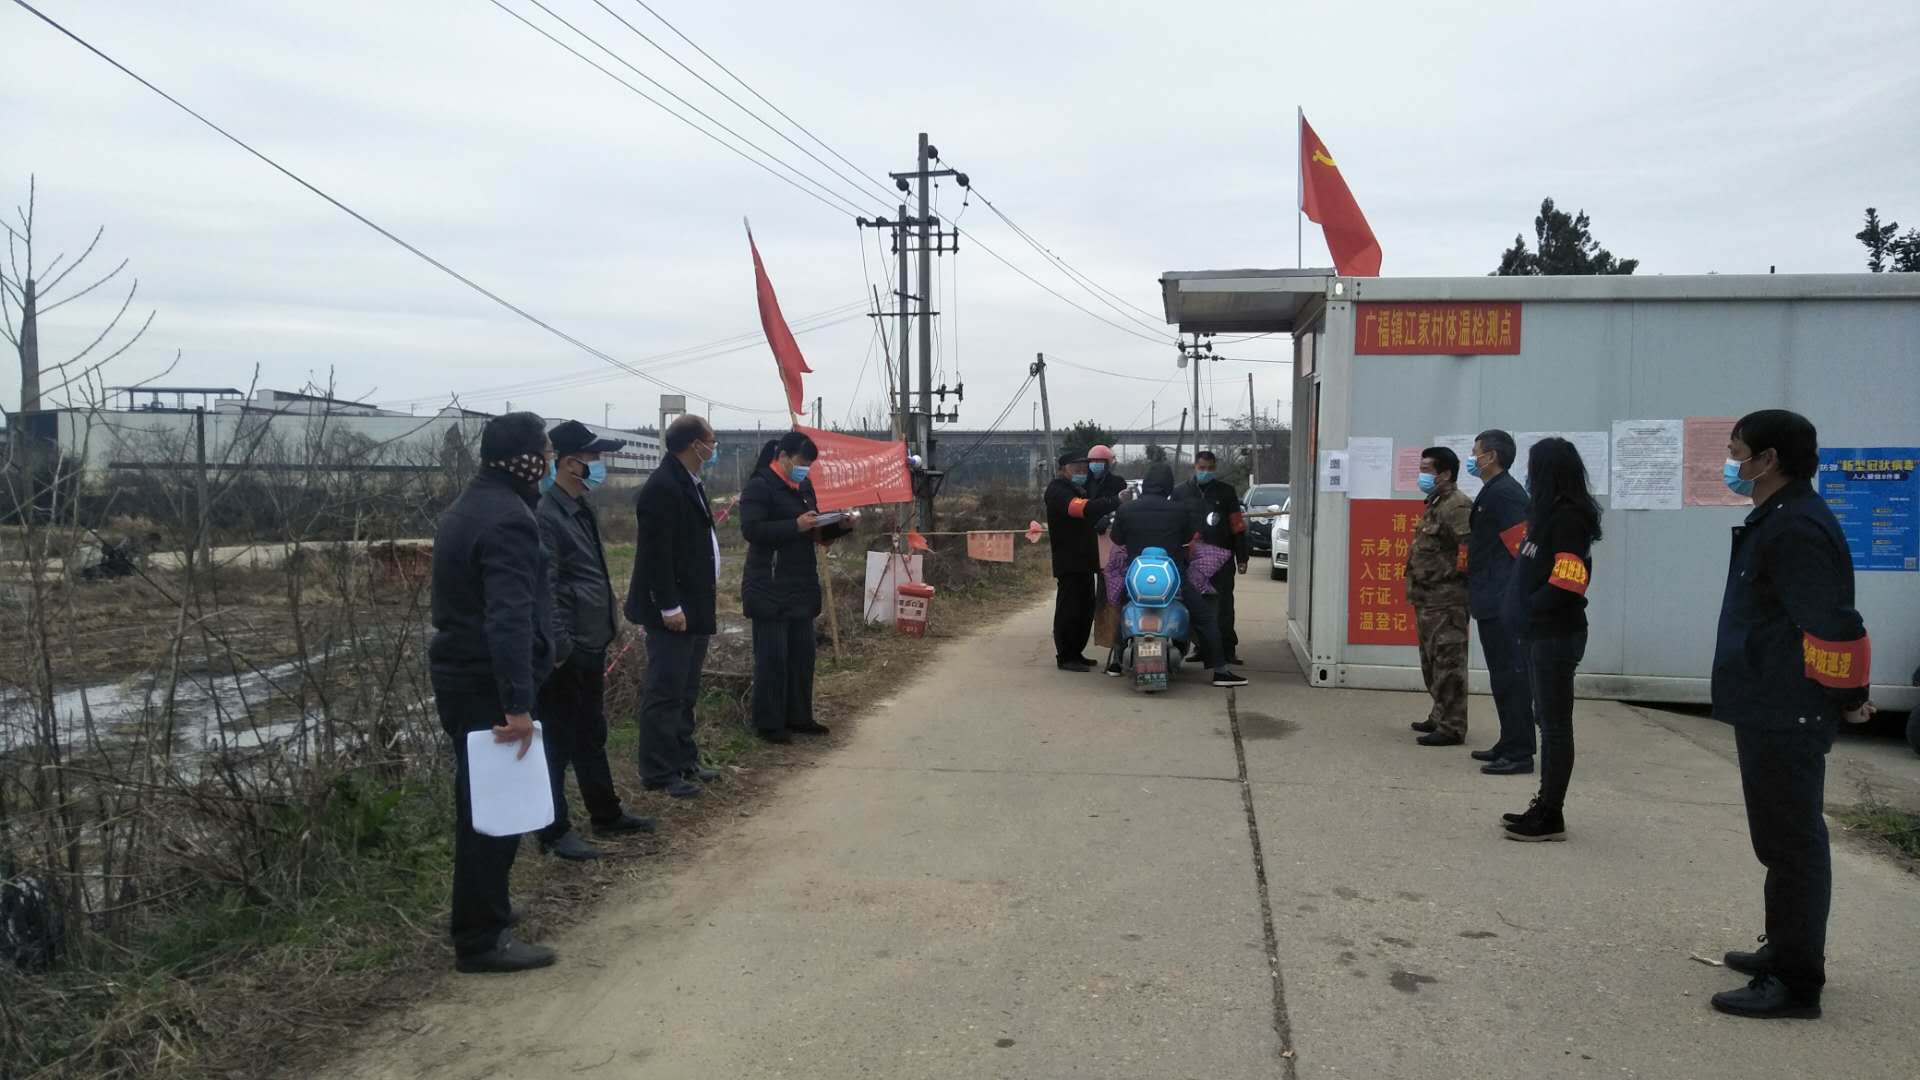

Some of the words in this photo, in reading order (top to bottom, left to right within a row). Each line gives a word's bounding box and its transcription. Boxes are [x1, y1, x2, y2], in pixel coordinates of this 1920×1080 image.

[1364, 309, 1512, 347] 广福镇江家村体温检测点
